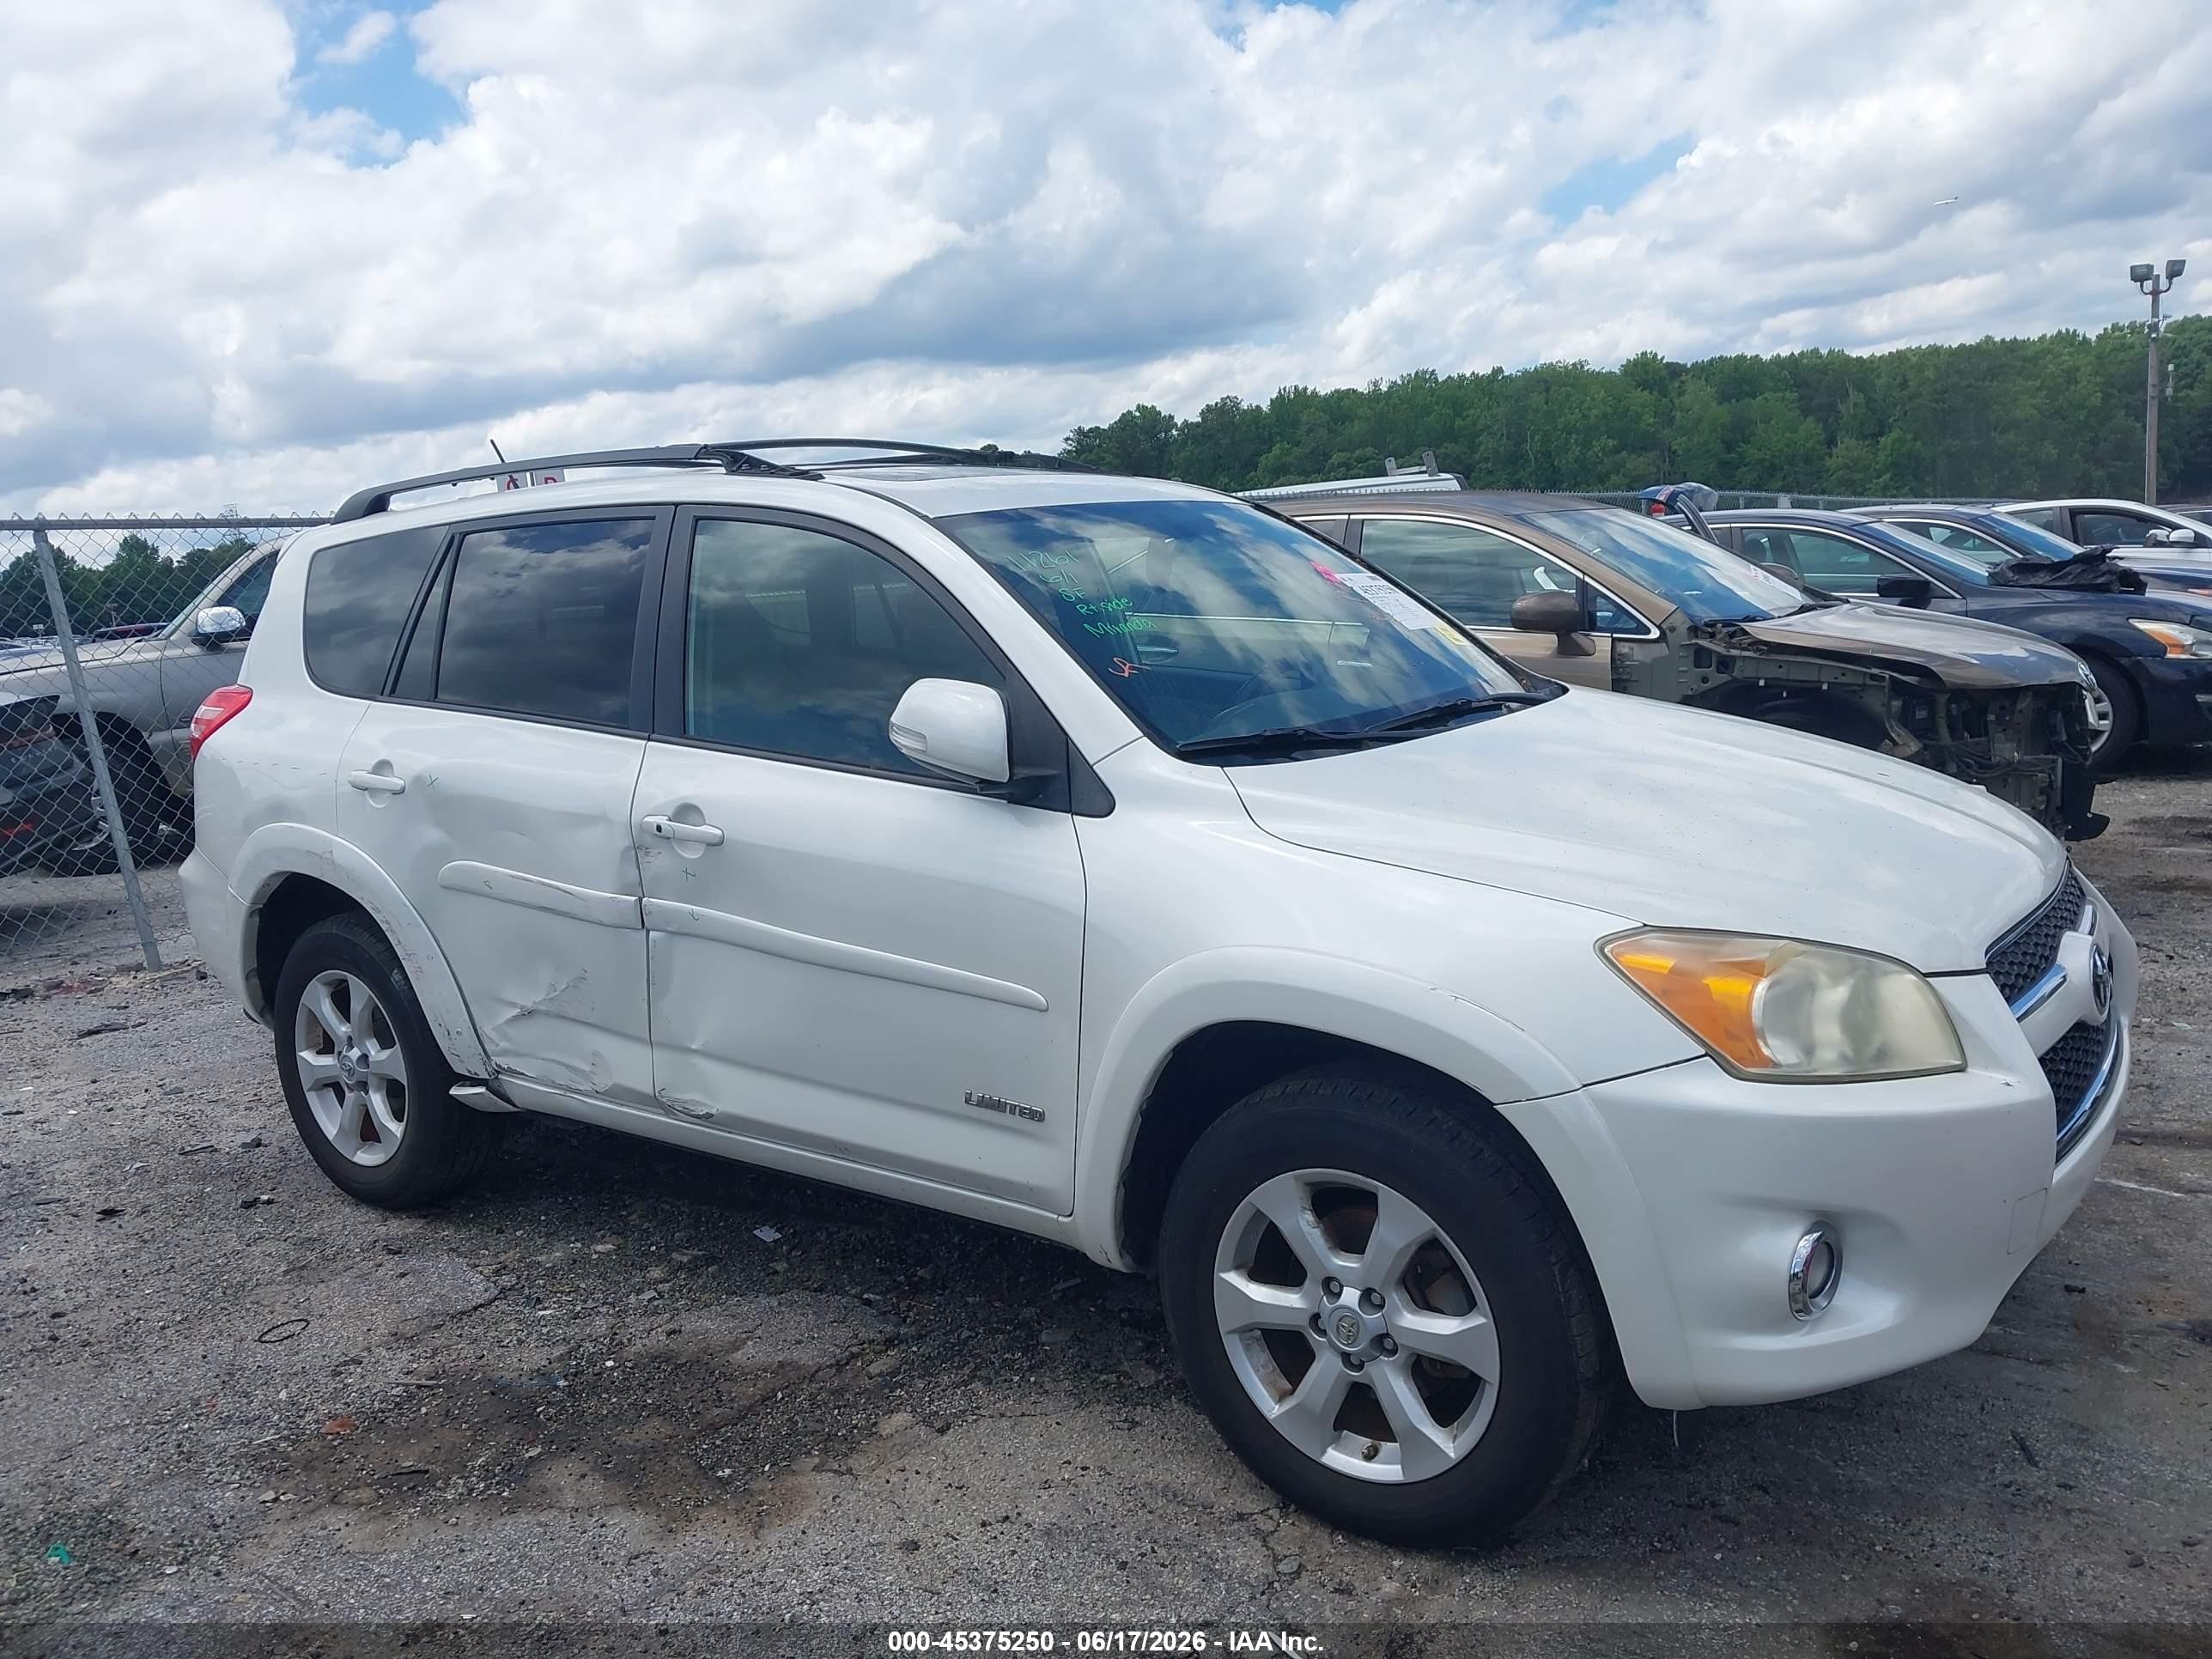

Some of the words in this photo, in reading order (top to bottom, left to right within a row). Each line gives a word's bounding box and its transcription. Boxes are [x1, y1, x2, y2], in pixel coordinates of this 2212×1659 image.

[1006, 550, 1079, 571] 11261
[1100, 598, 1133, 612] side
[964, 1090, 1045, 1122] LIMITED
